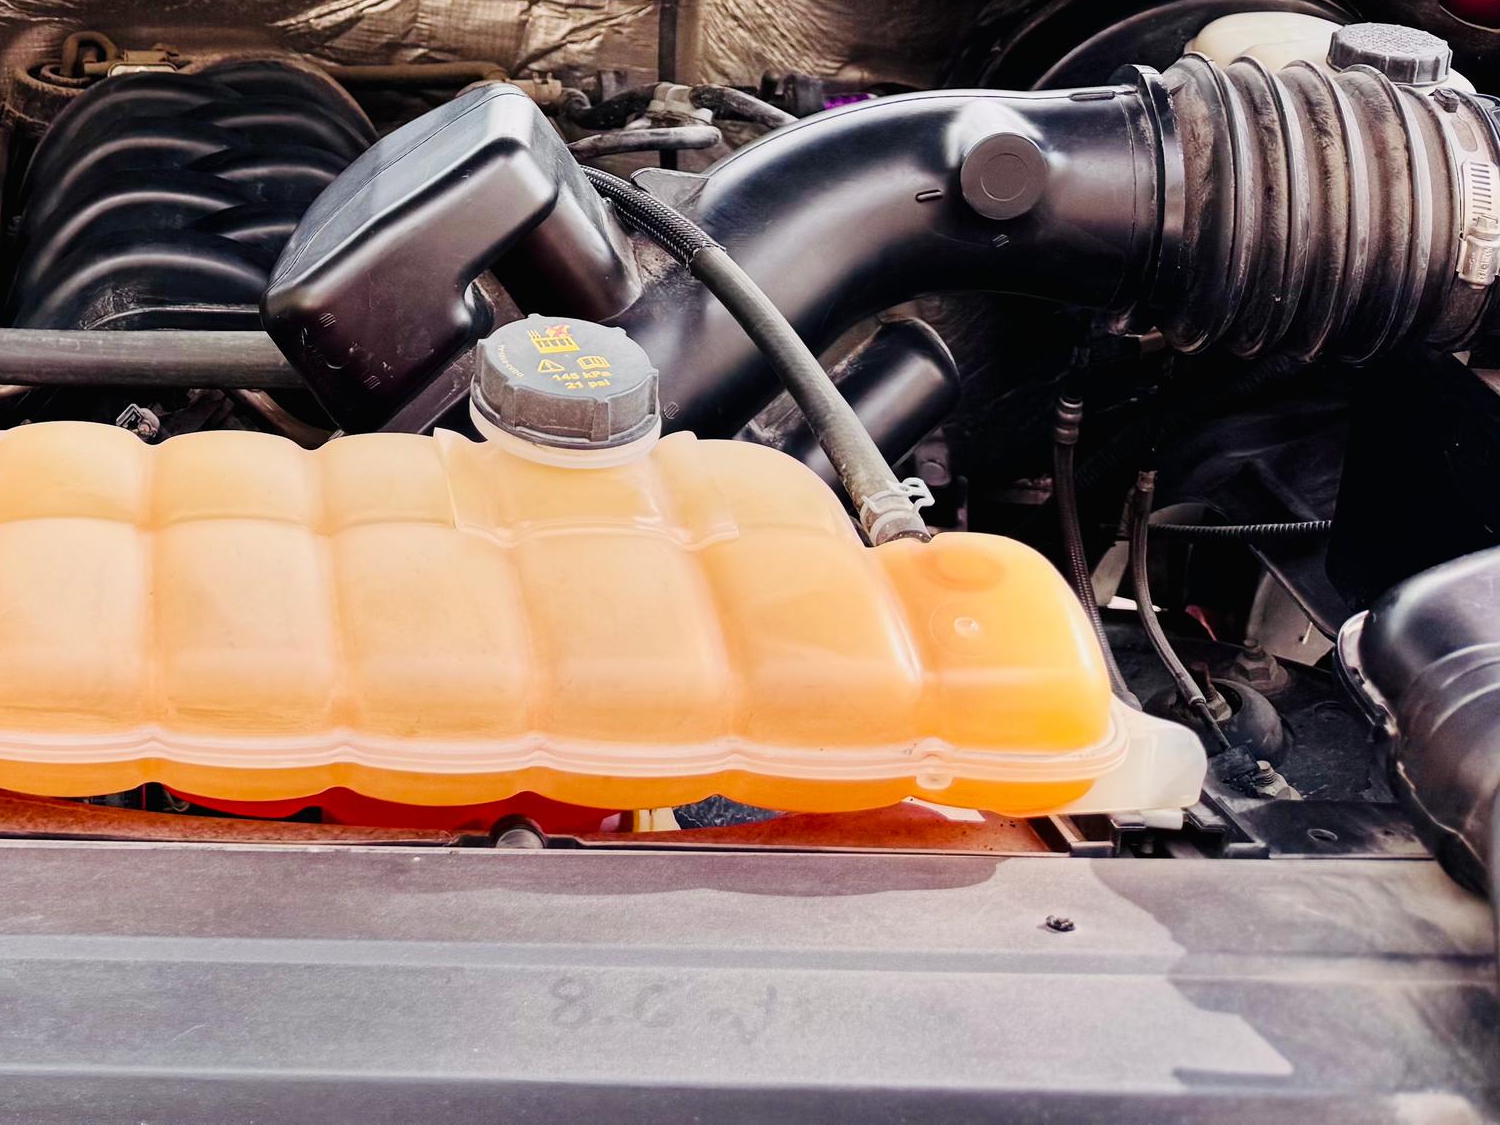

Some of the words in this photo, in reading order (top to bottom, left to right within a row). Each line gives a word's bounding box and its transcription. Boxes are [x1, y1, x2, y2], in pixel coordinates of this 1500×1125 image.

[551, 373, 580, 381] 145
[582, 370, 613, 380] kPa
[564, 380, 584, 390] 21
[588, 378, 612, 389] psi
